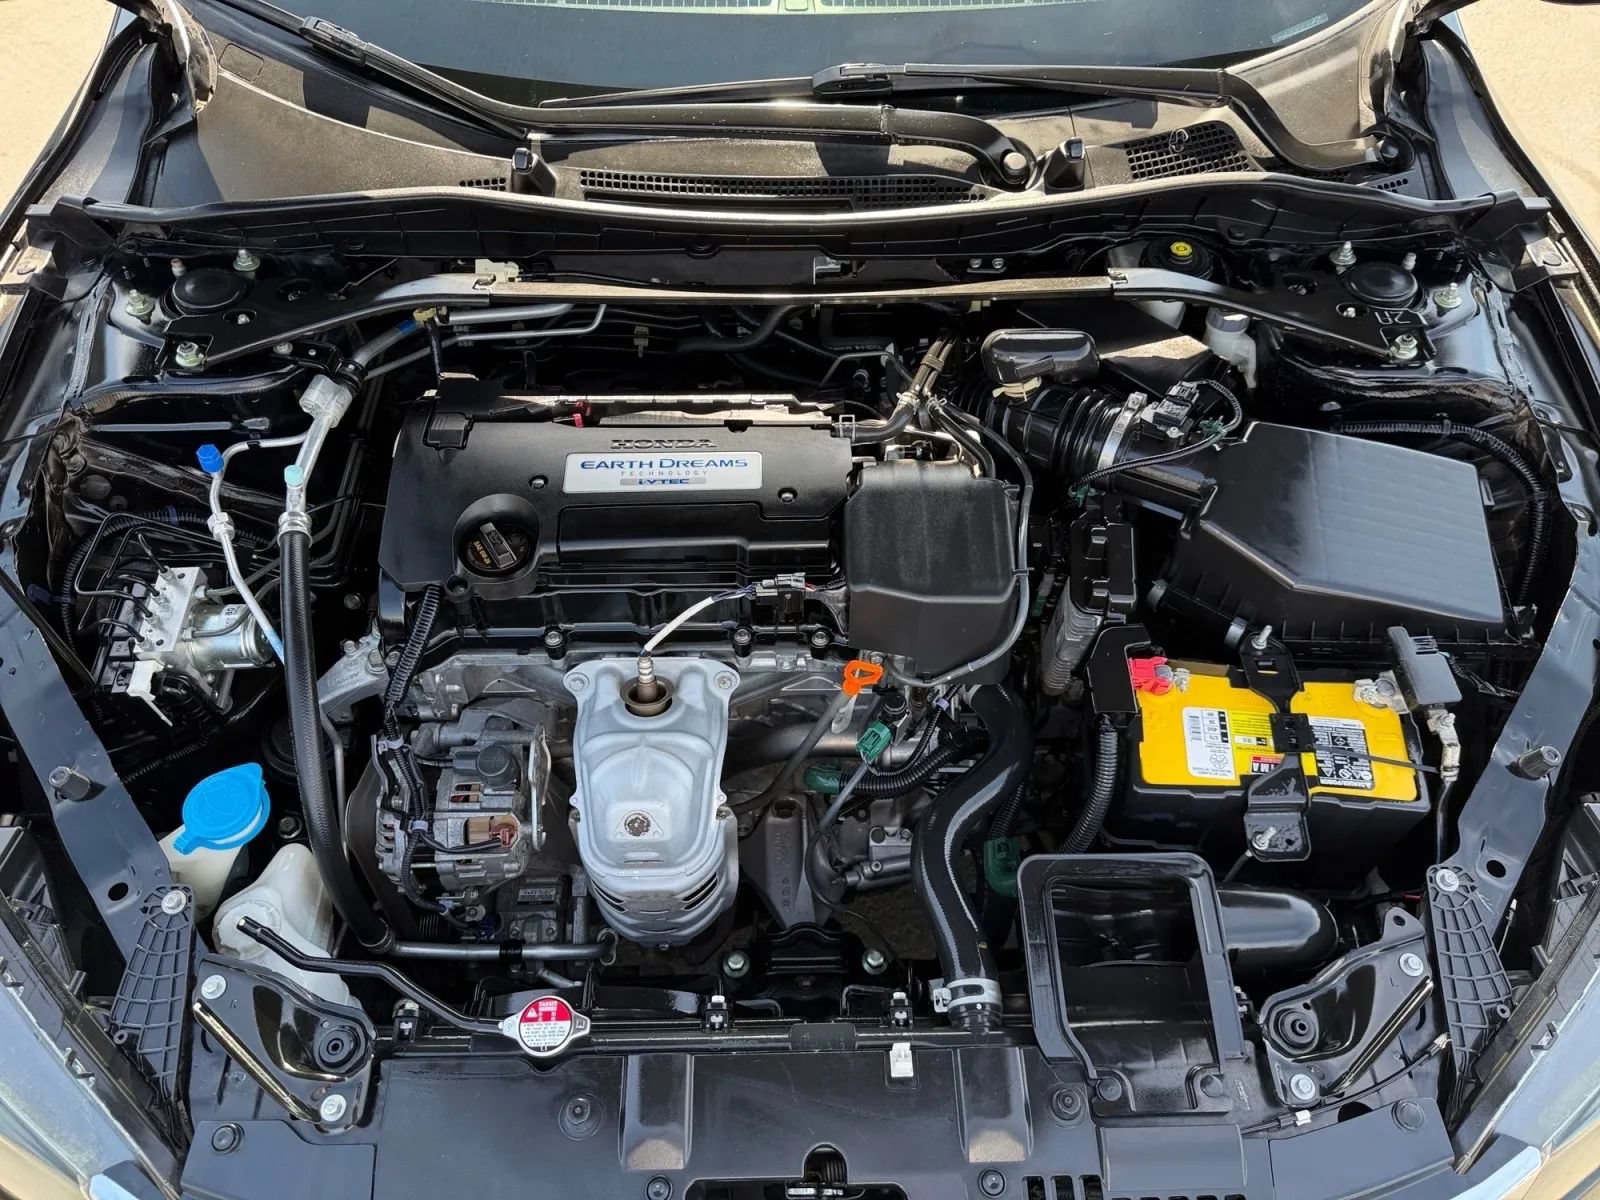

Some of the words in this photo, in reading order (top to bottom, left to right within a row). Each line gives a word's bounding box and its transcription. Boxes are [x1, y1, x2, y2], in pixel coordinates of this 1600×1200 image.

[610, 439, 719, 449] HONDA
[580, 460, 653, 470] EARTH
[659, 458, 748, 469] DREAMS
